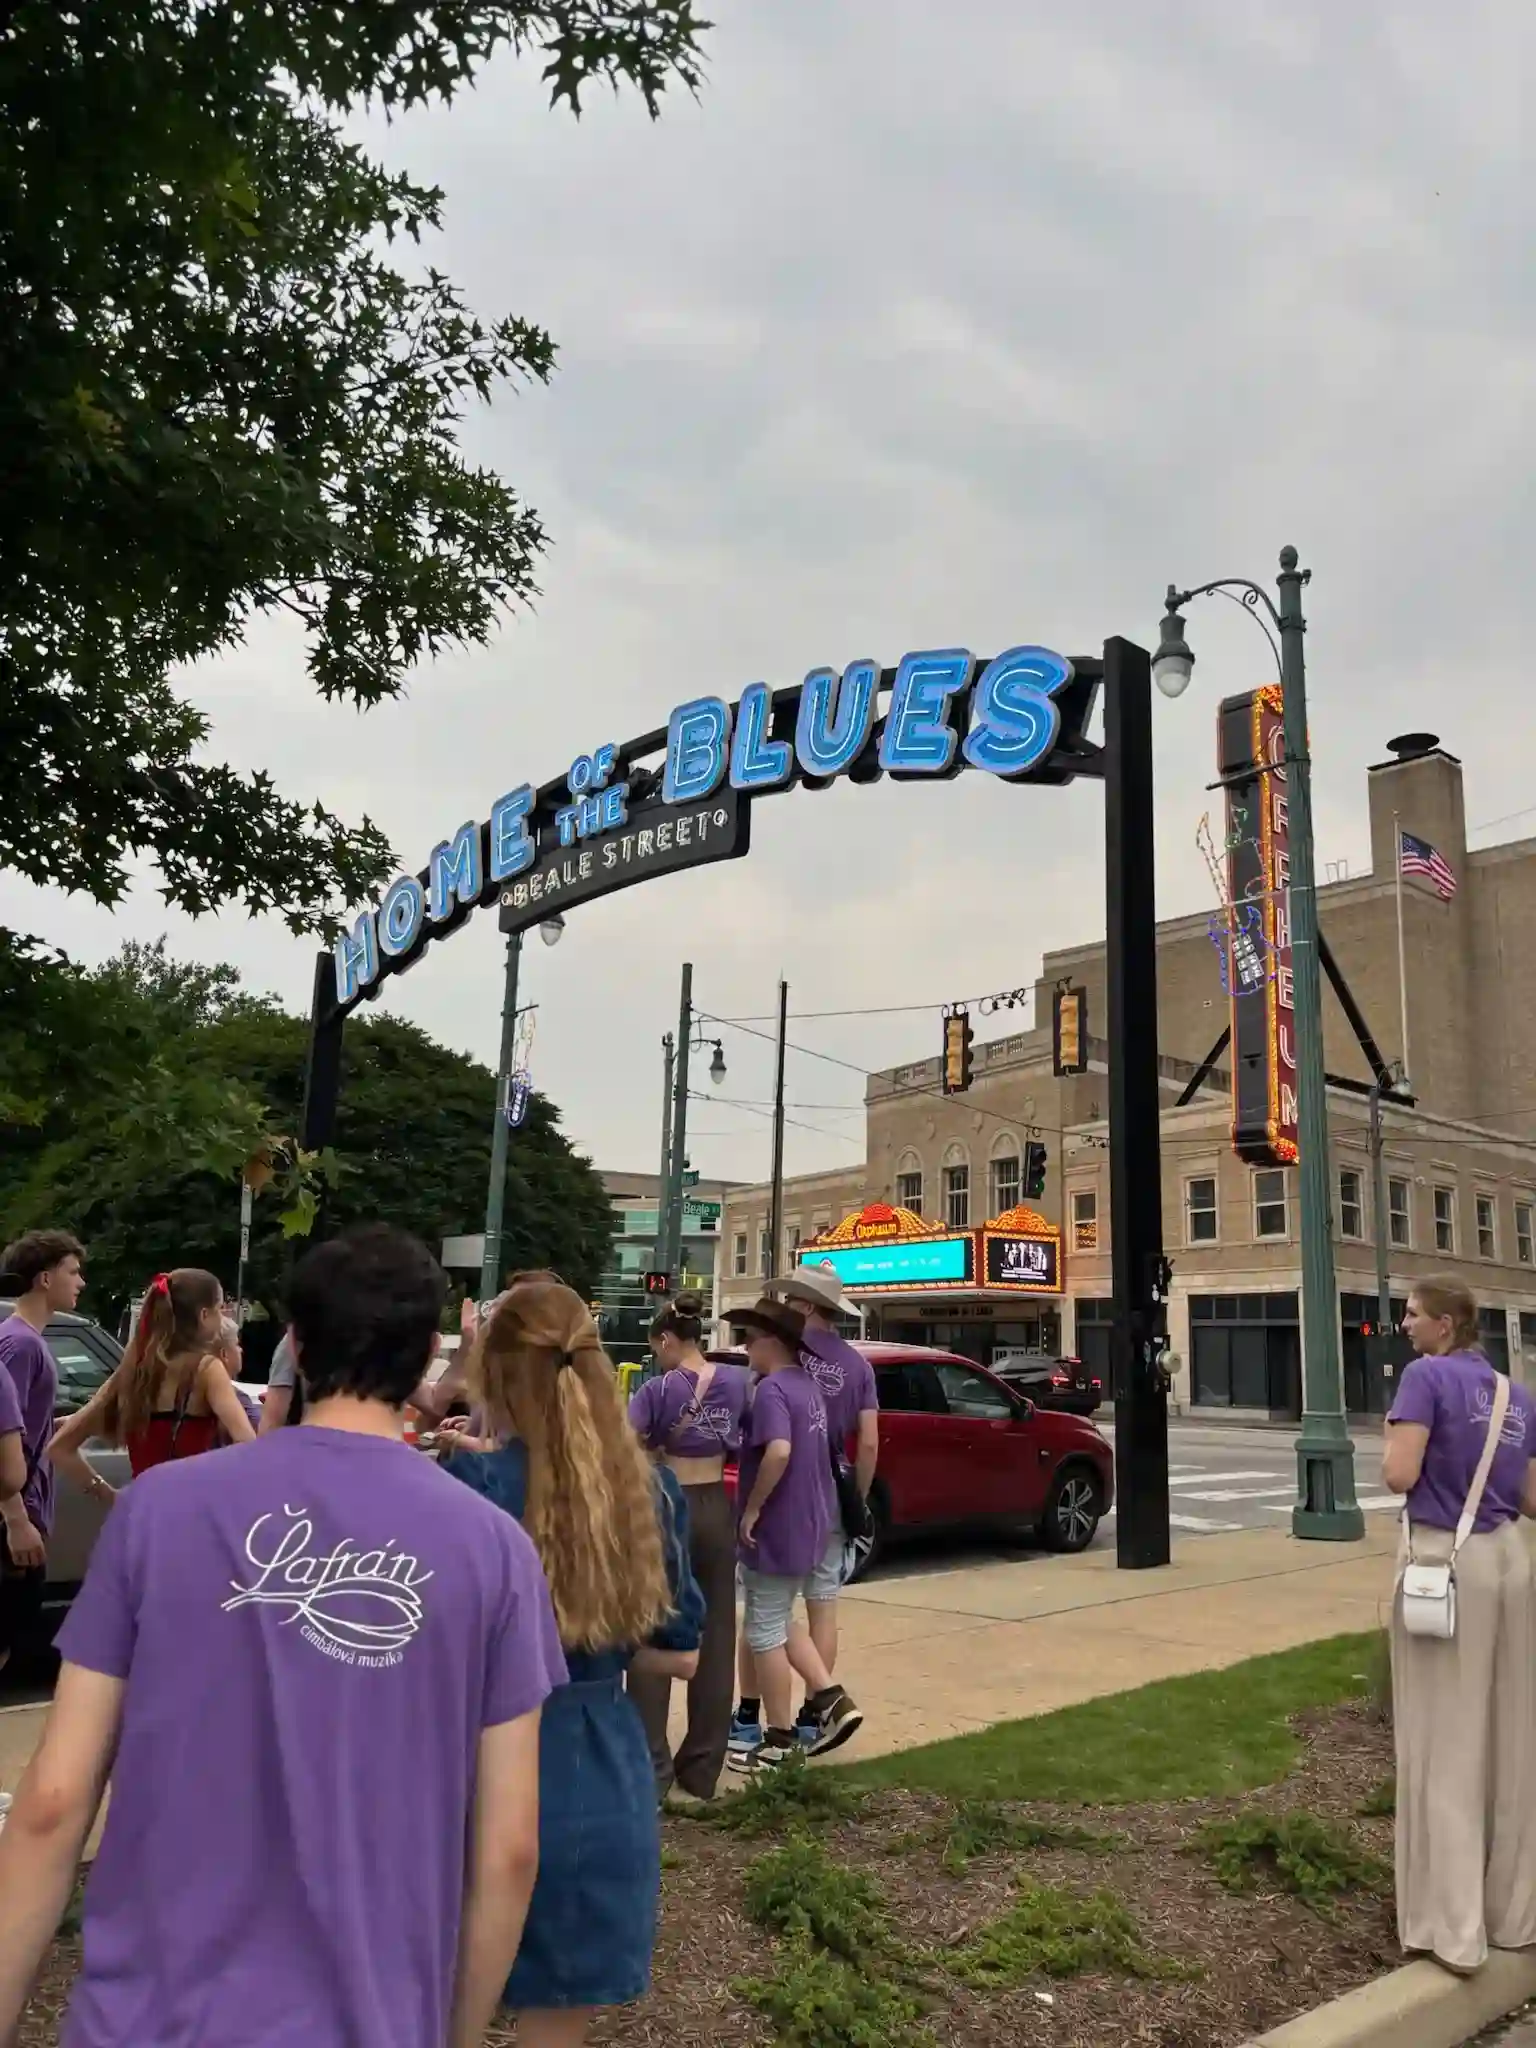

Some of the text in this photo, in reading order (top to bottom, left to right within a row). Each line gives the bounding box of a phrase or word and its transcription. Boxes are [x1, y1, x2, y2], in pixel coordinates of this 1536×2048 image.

[335, 645, 1075, 1003] HOME OF THE BLUES
[513, 811, 712, 909] BEALE STREET
[684, 1202, 710, 1217] Beale
[230, 1503, 435, 1624] Šafrán
[299, 1624, 404, 1668] cimbálová muzika
